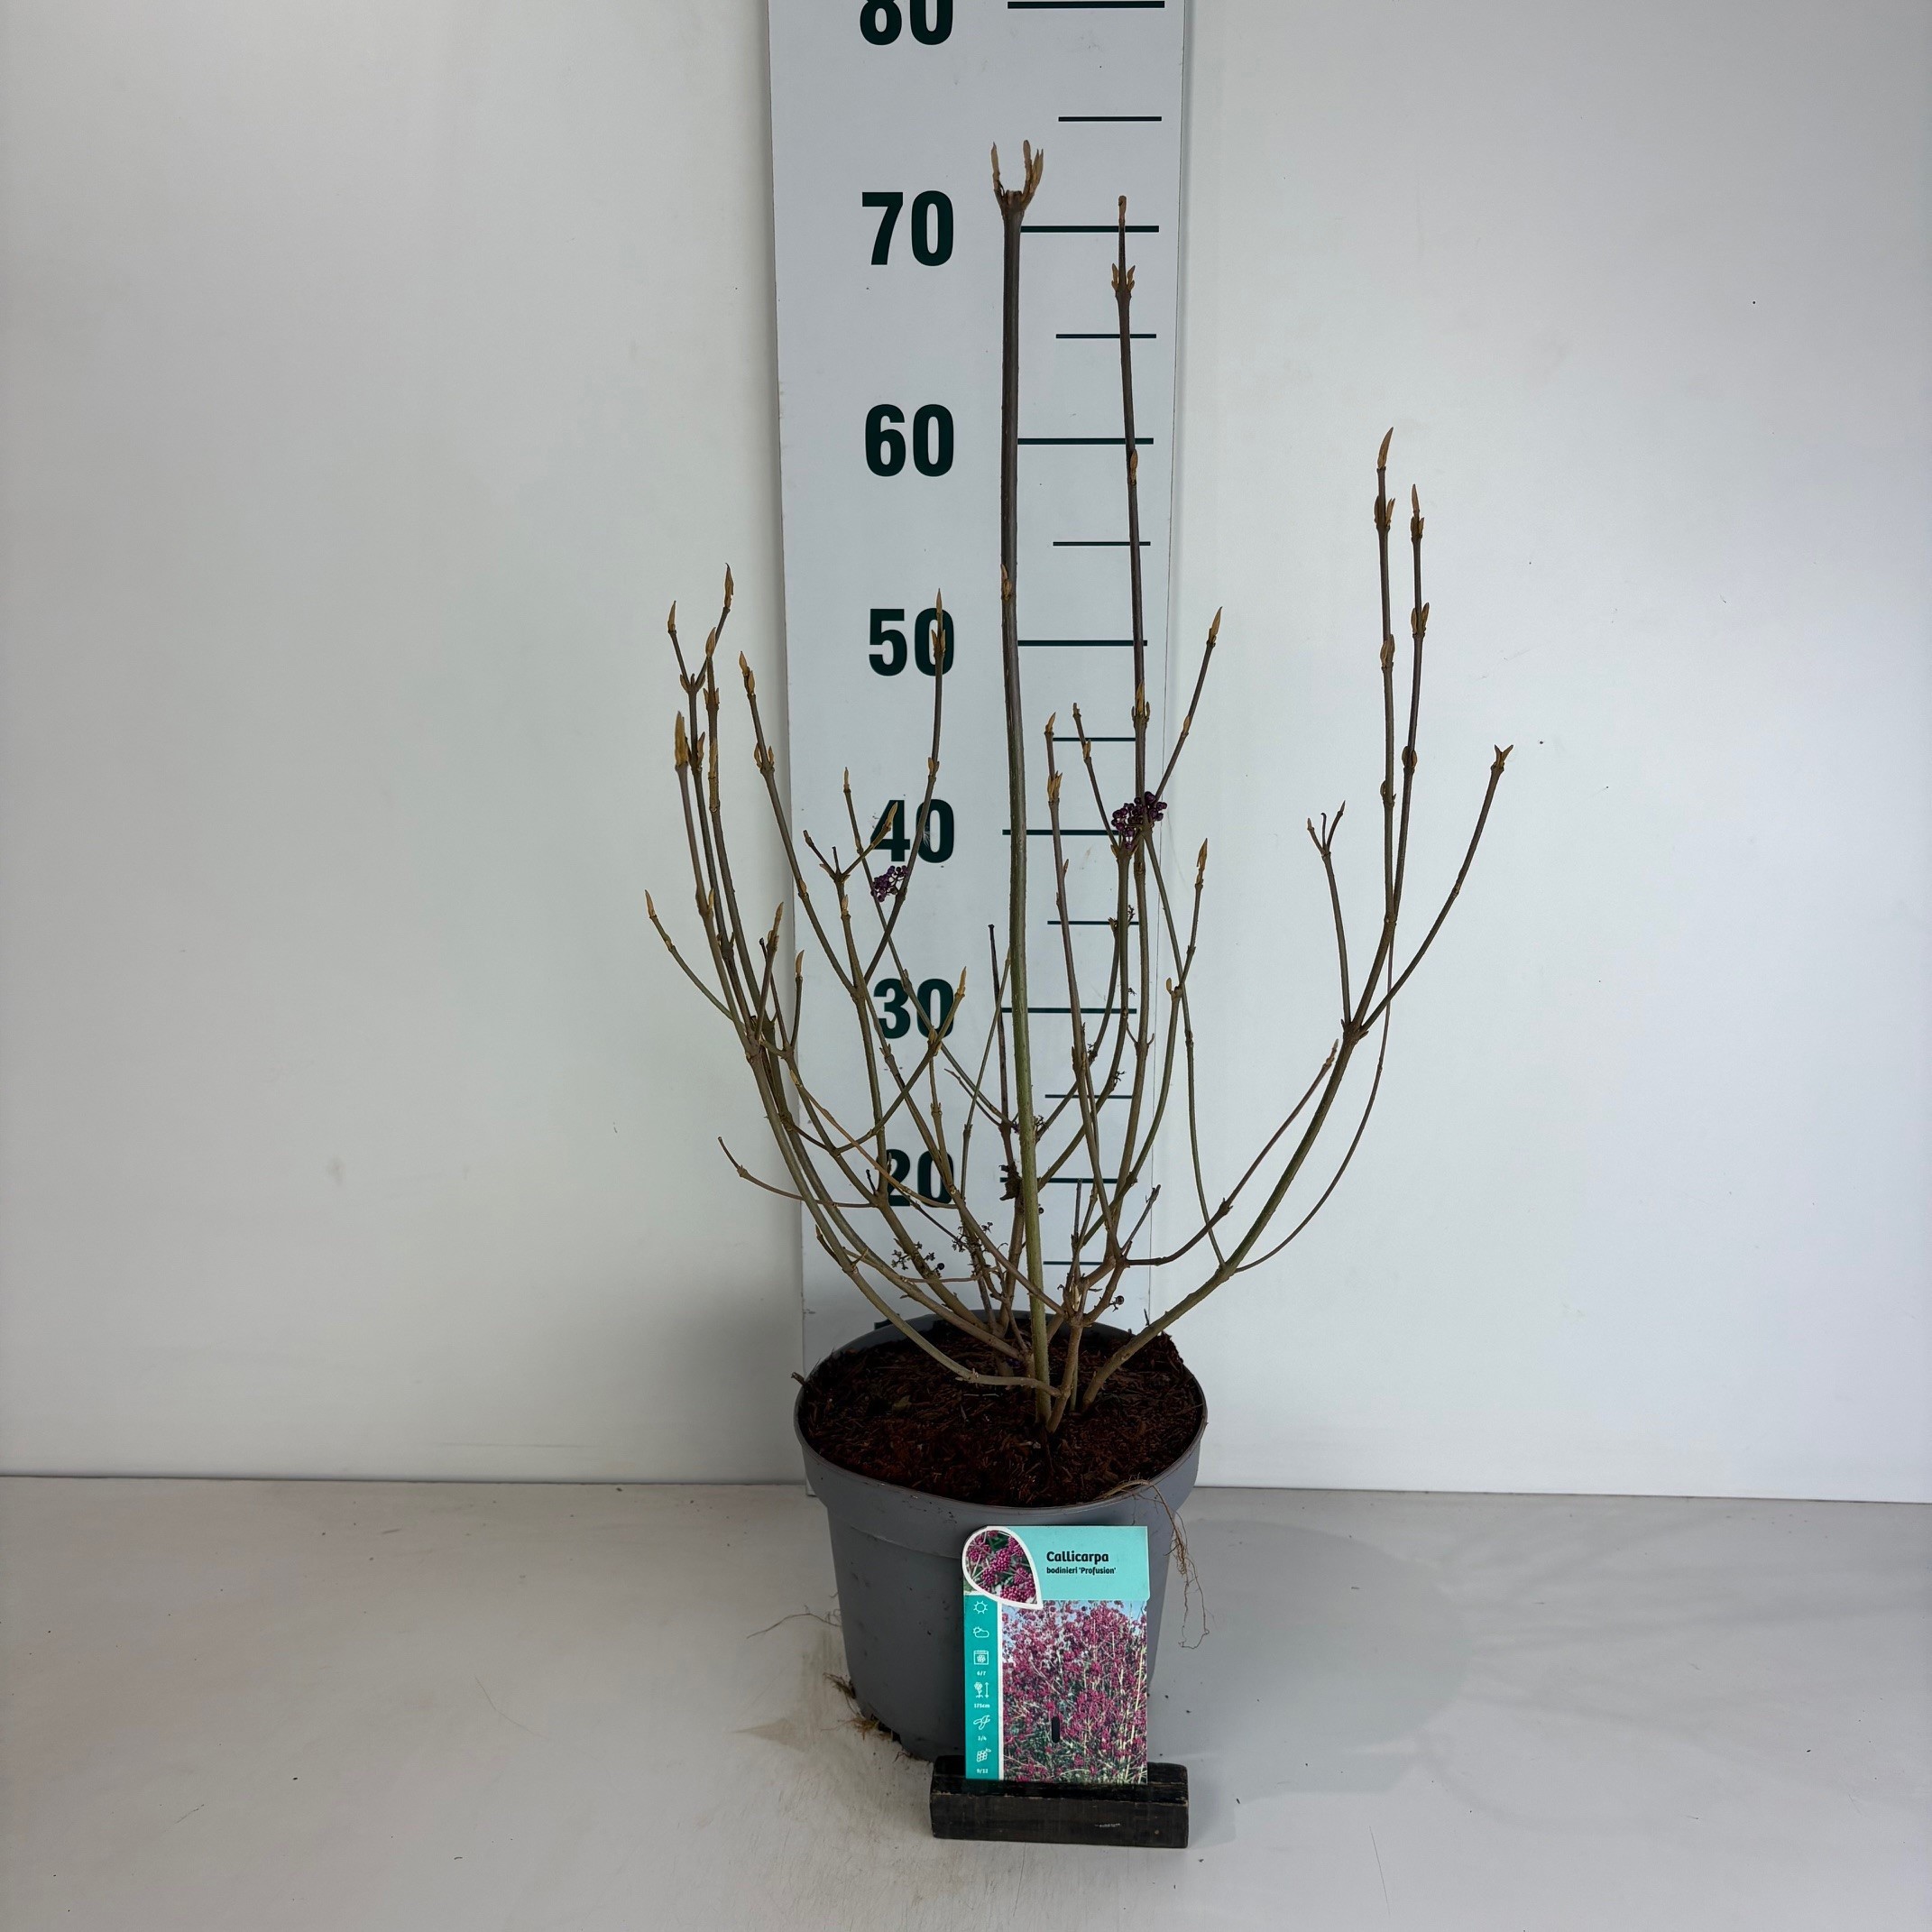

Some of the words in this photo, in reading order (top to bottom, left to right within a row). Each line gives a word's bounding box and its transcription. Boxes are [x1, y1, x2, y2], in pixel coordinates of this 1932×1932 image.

[860, 0, 953, 45] 80
[861, 189, 954, 267] 70
[865, 403, 954, 477] 60
[869, 607, 954, 676] 50
[869, 799, 954, 863] 40
[873, 978, 954, 1039] 30
[876, 1148, 954, 1207] 20
[1046, 1550, 1109, 1565] Callicarpa
[1079, 1567, 1116, 1576] 'Profusion'
